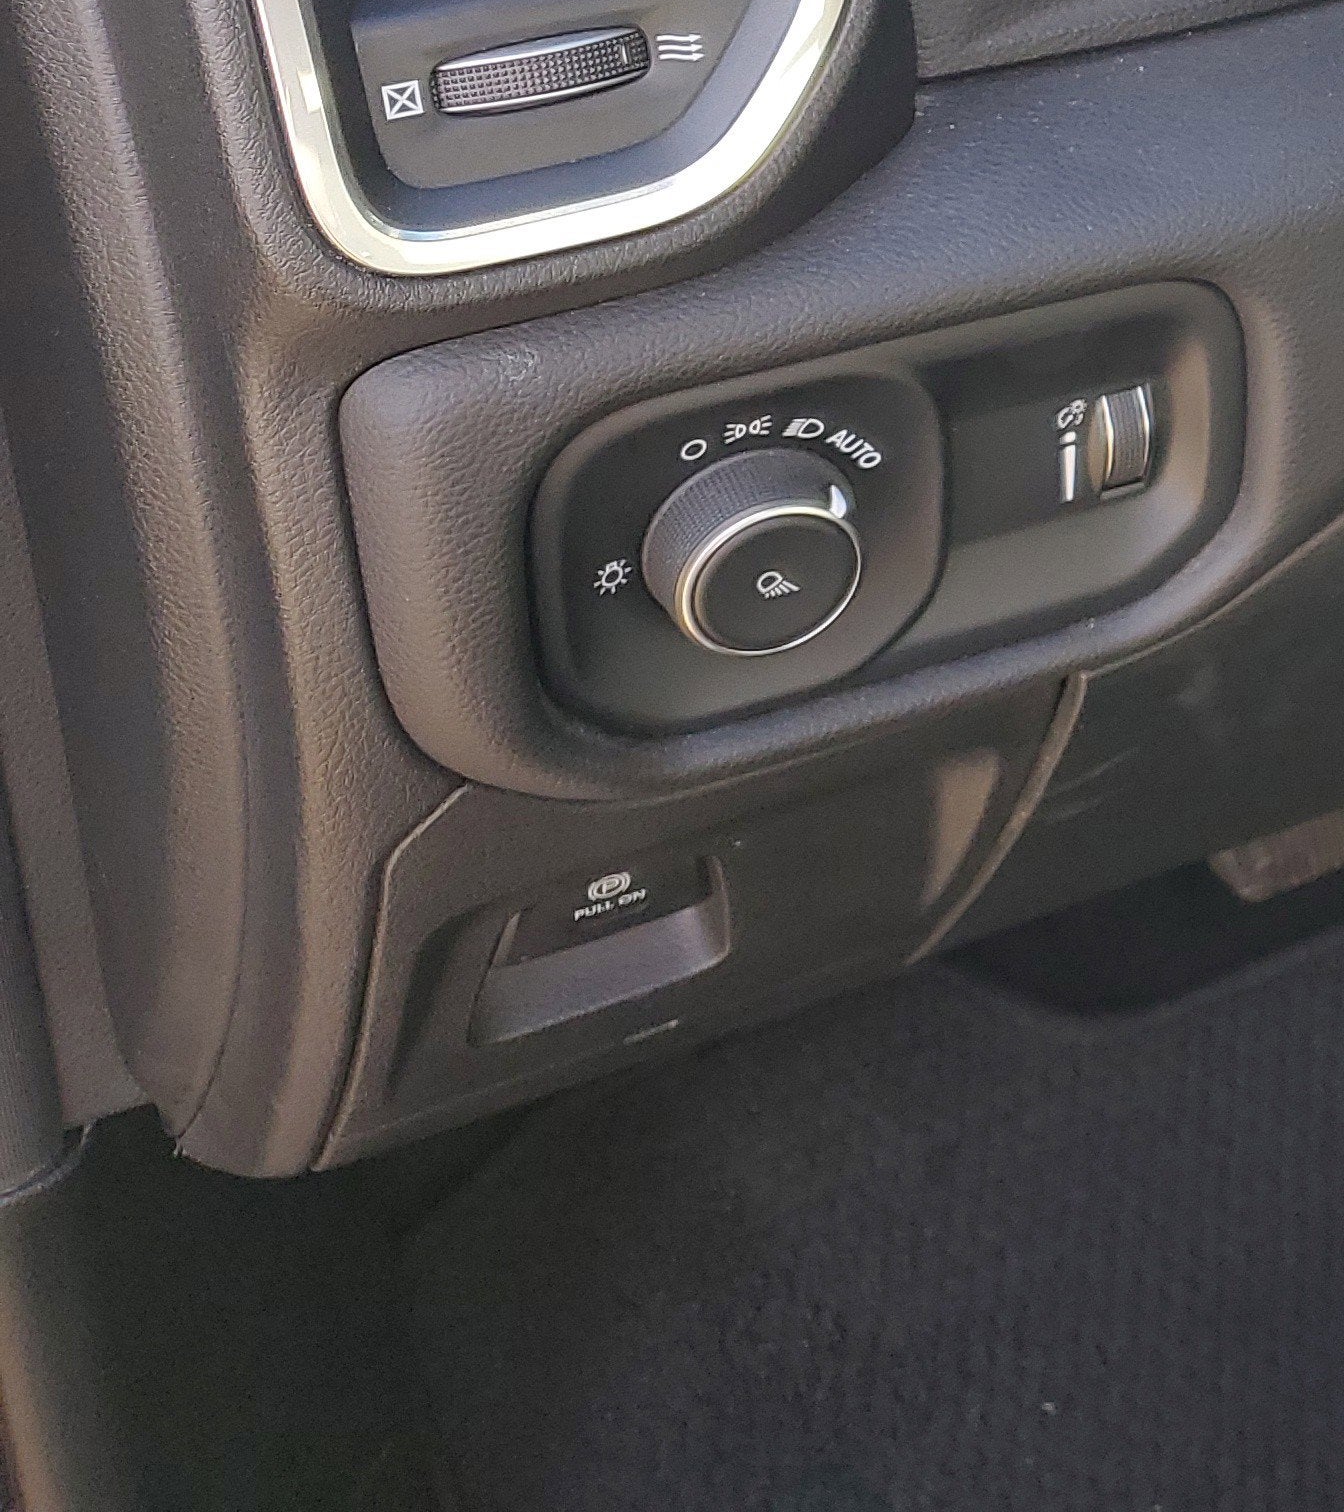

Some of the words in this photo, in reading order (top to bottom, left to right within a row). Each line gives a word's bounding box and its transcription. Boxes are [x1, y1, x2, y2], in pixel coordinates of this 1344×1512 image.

[824, 428, 882, 469] AUTO
[573, 900, 614, 922] PULL
[618, 887, 647, 907] ON
